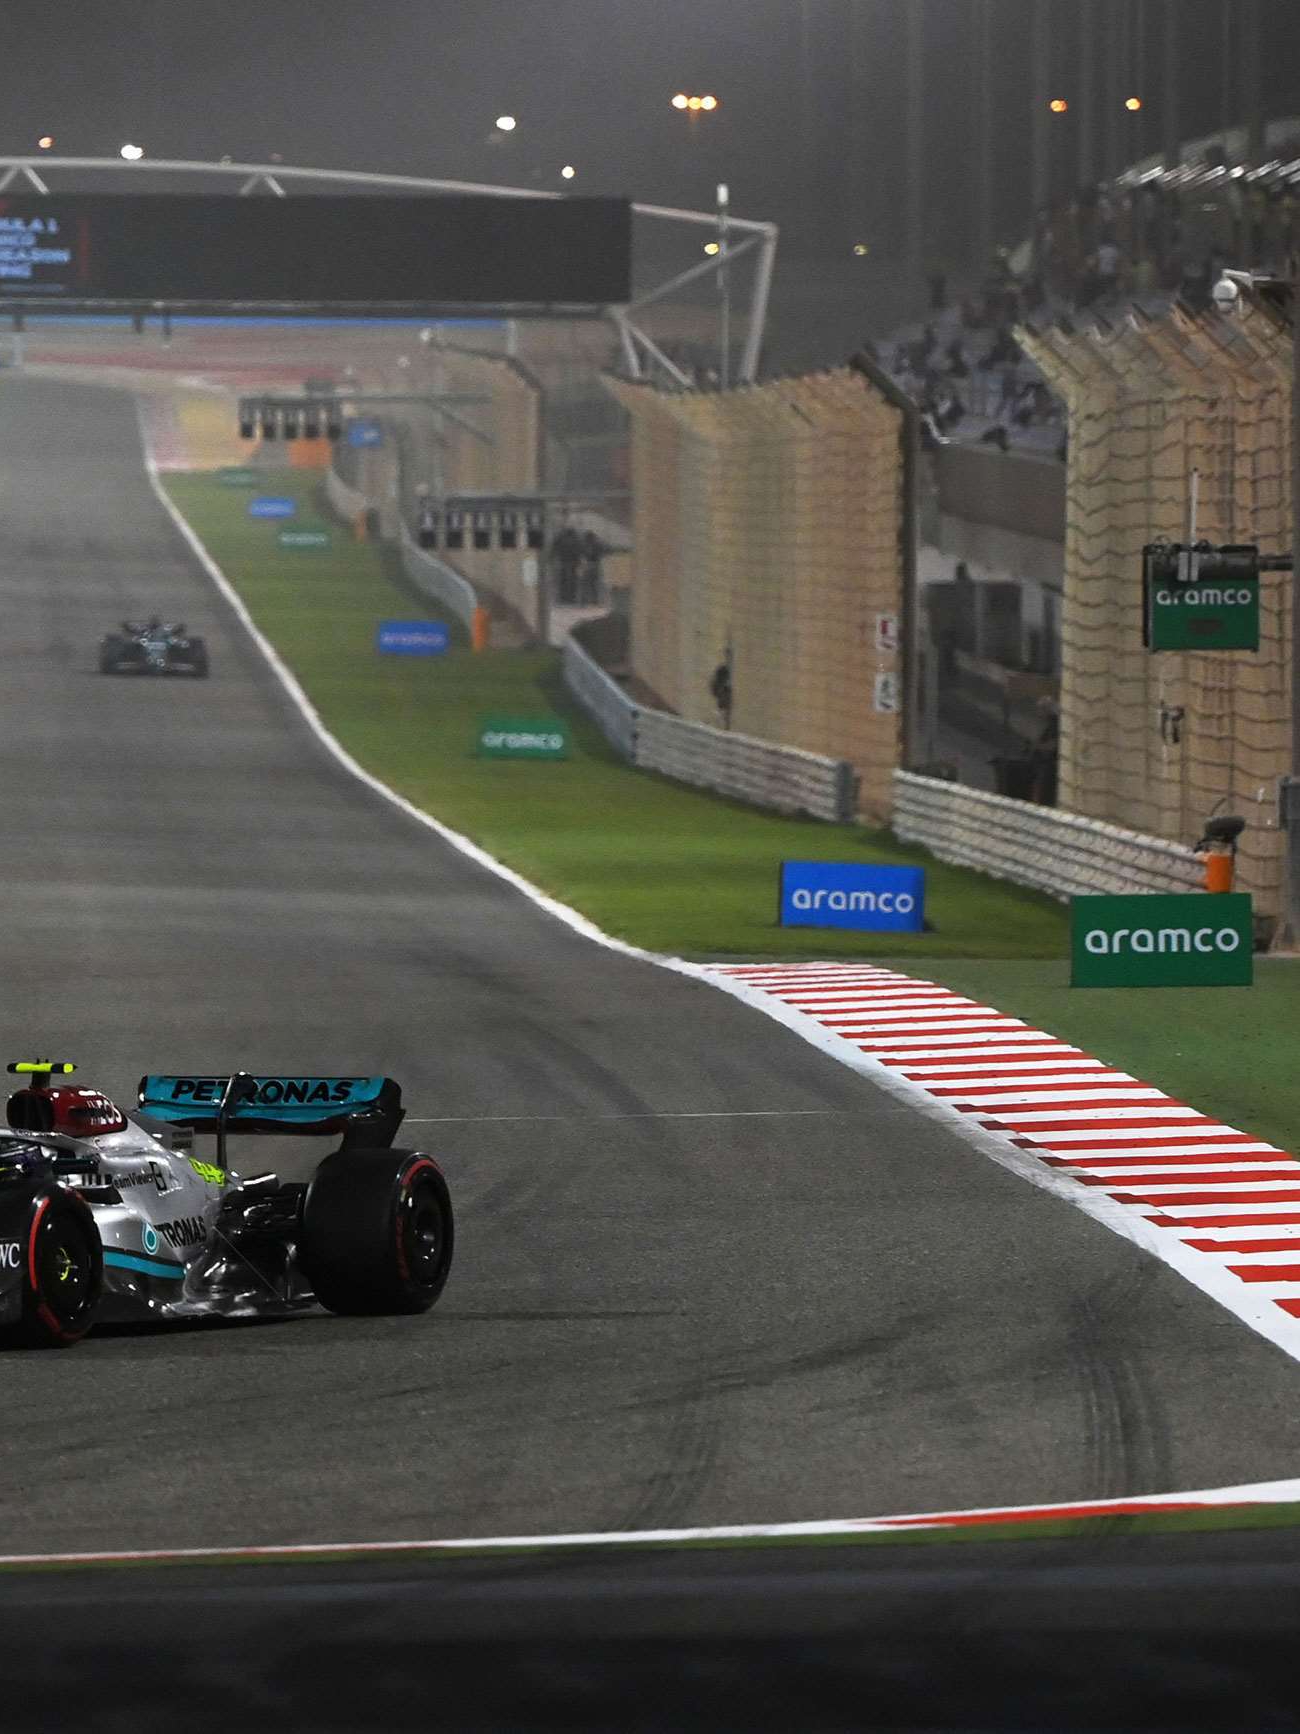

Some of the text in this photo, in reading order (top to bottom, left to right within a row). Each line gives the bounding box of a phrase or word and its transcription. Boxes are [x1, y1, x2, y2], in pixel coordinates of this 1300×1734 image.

[1156, 589, 1252, 605] aramco
[791, 888, 914, 914] aramco
[1084, 928, 1240, 954] aramco
